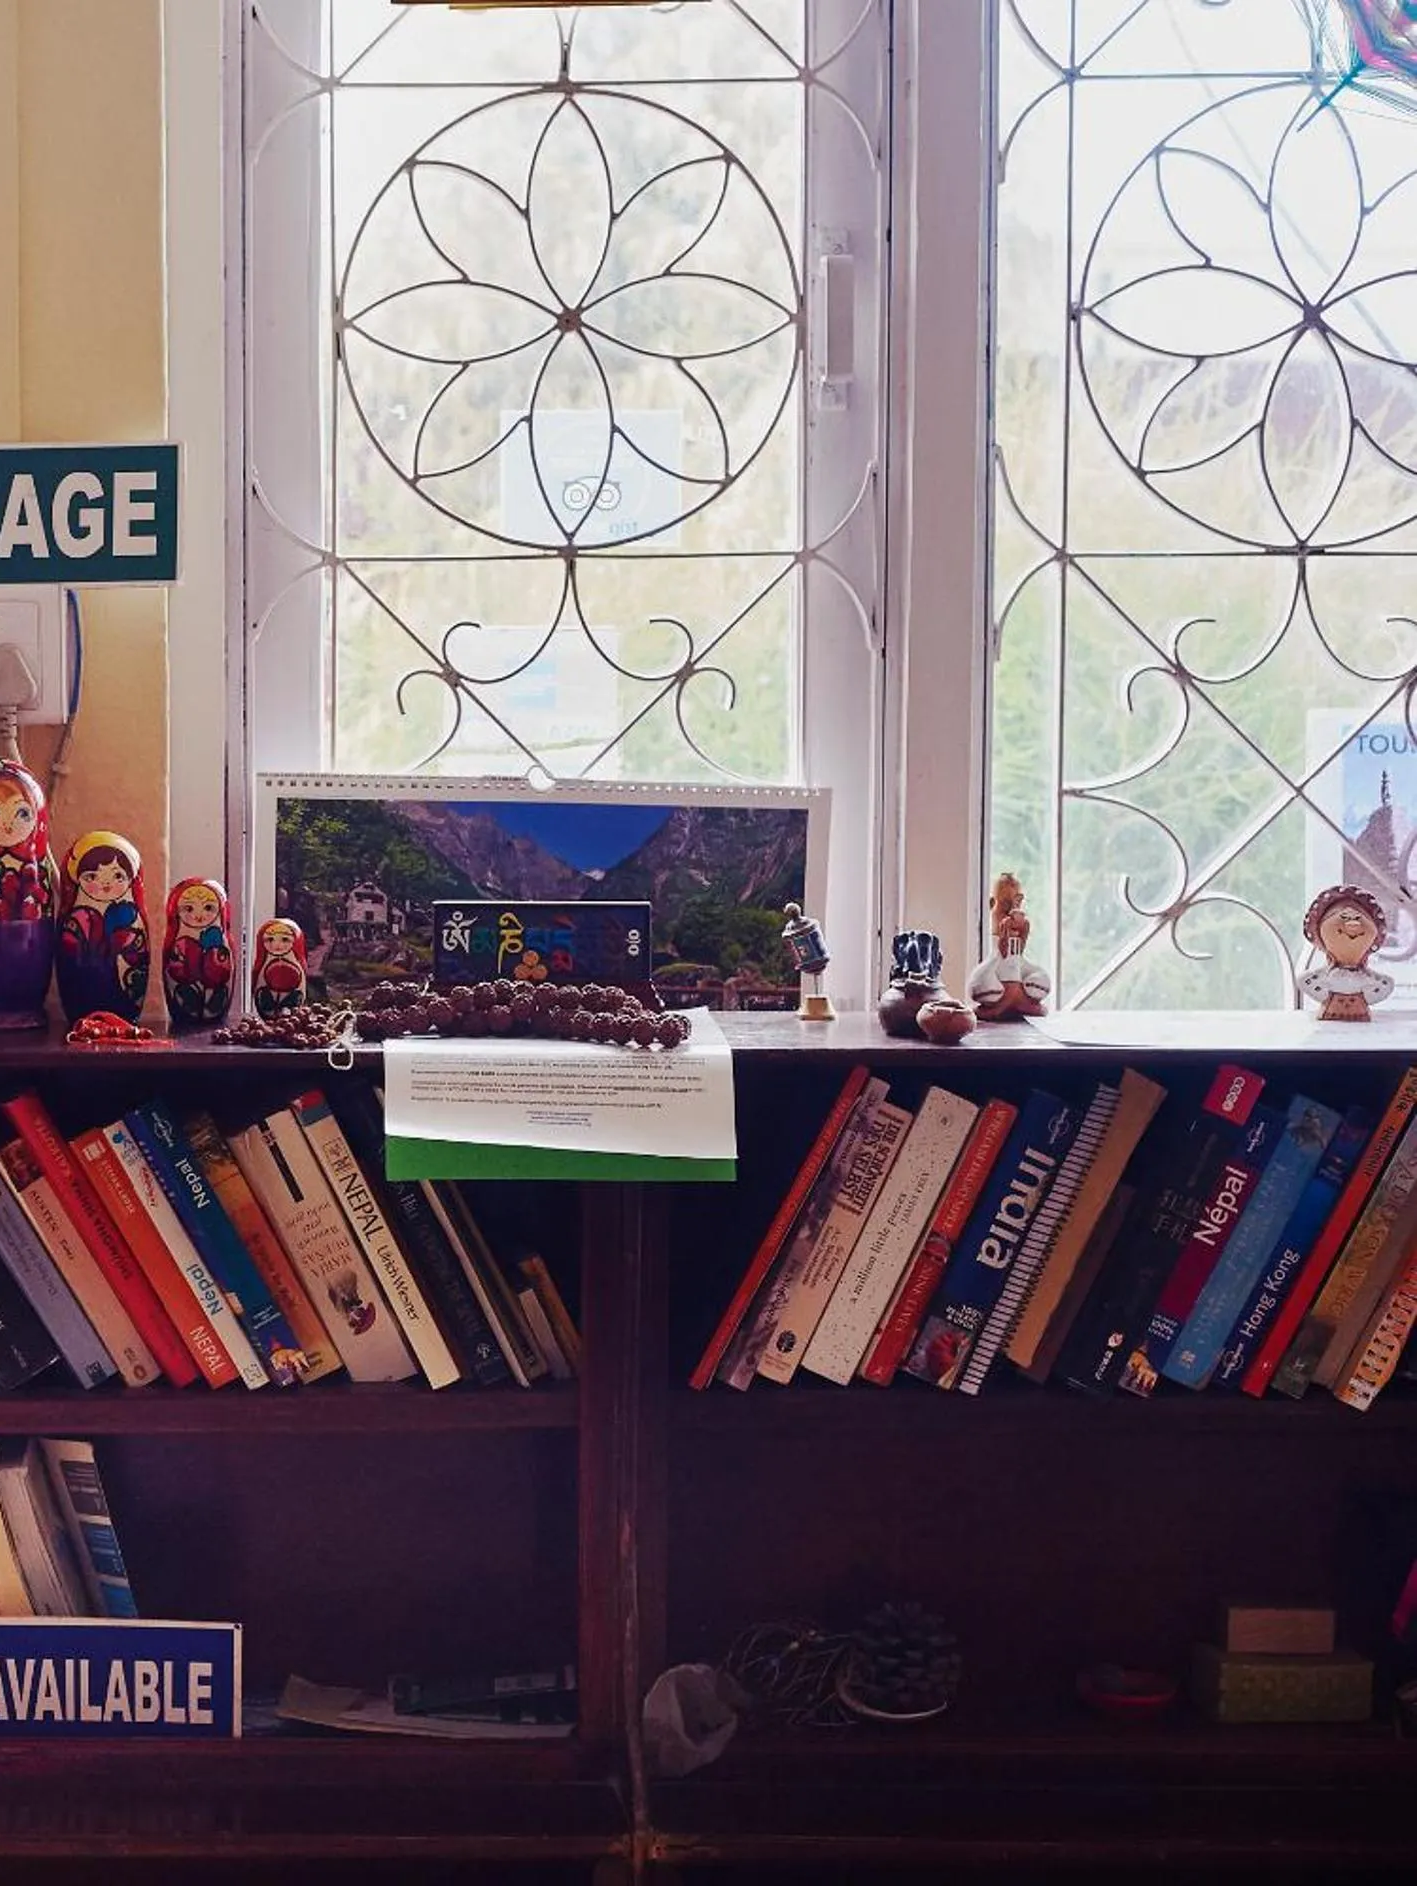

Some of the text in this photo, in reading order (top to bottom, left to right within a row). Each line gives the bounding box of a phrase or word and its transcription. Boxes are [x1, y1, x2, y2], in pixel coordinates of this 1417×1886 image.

[1358, 733, 1417, 754] TOU
[171, 1154, 214, 1209] Nepal
[336, 1170, 387, 1243] NEPAL
[1190, 1163, 1254, 1249] Népal
[849, 1253, 879, 1296] million
[869, 1224, 893, 1254] little
[884, 1190, 911, 1227] pieces
[1238, 1244, 1300, 1340] Hong Kong
[187, 1324, 226, 1376] NEPAL
